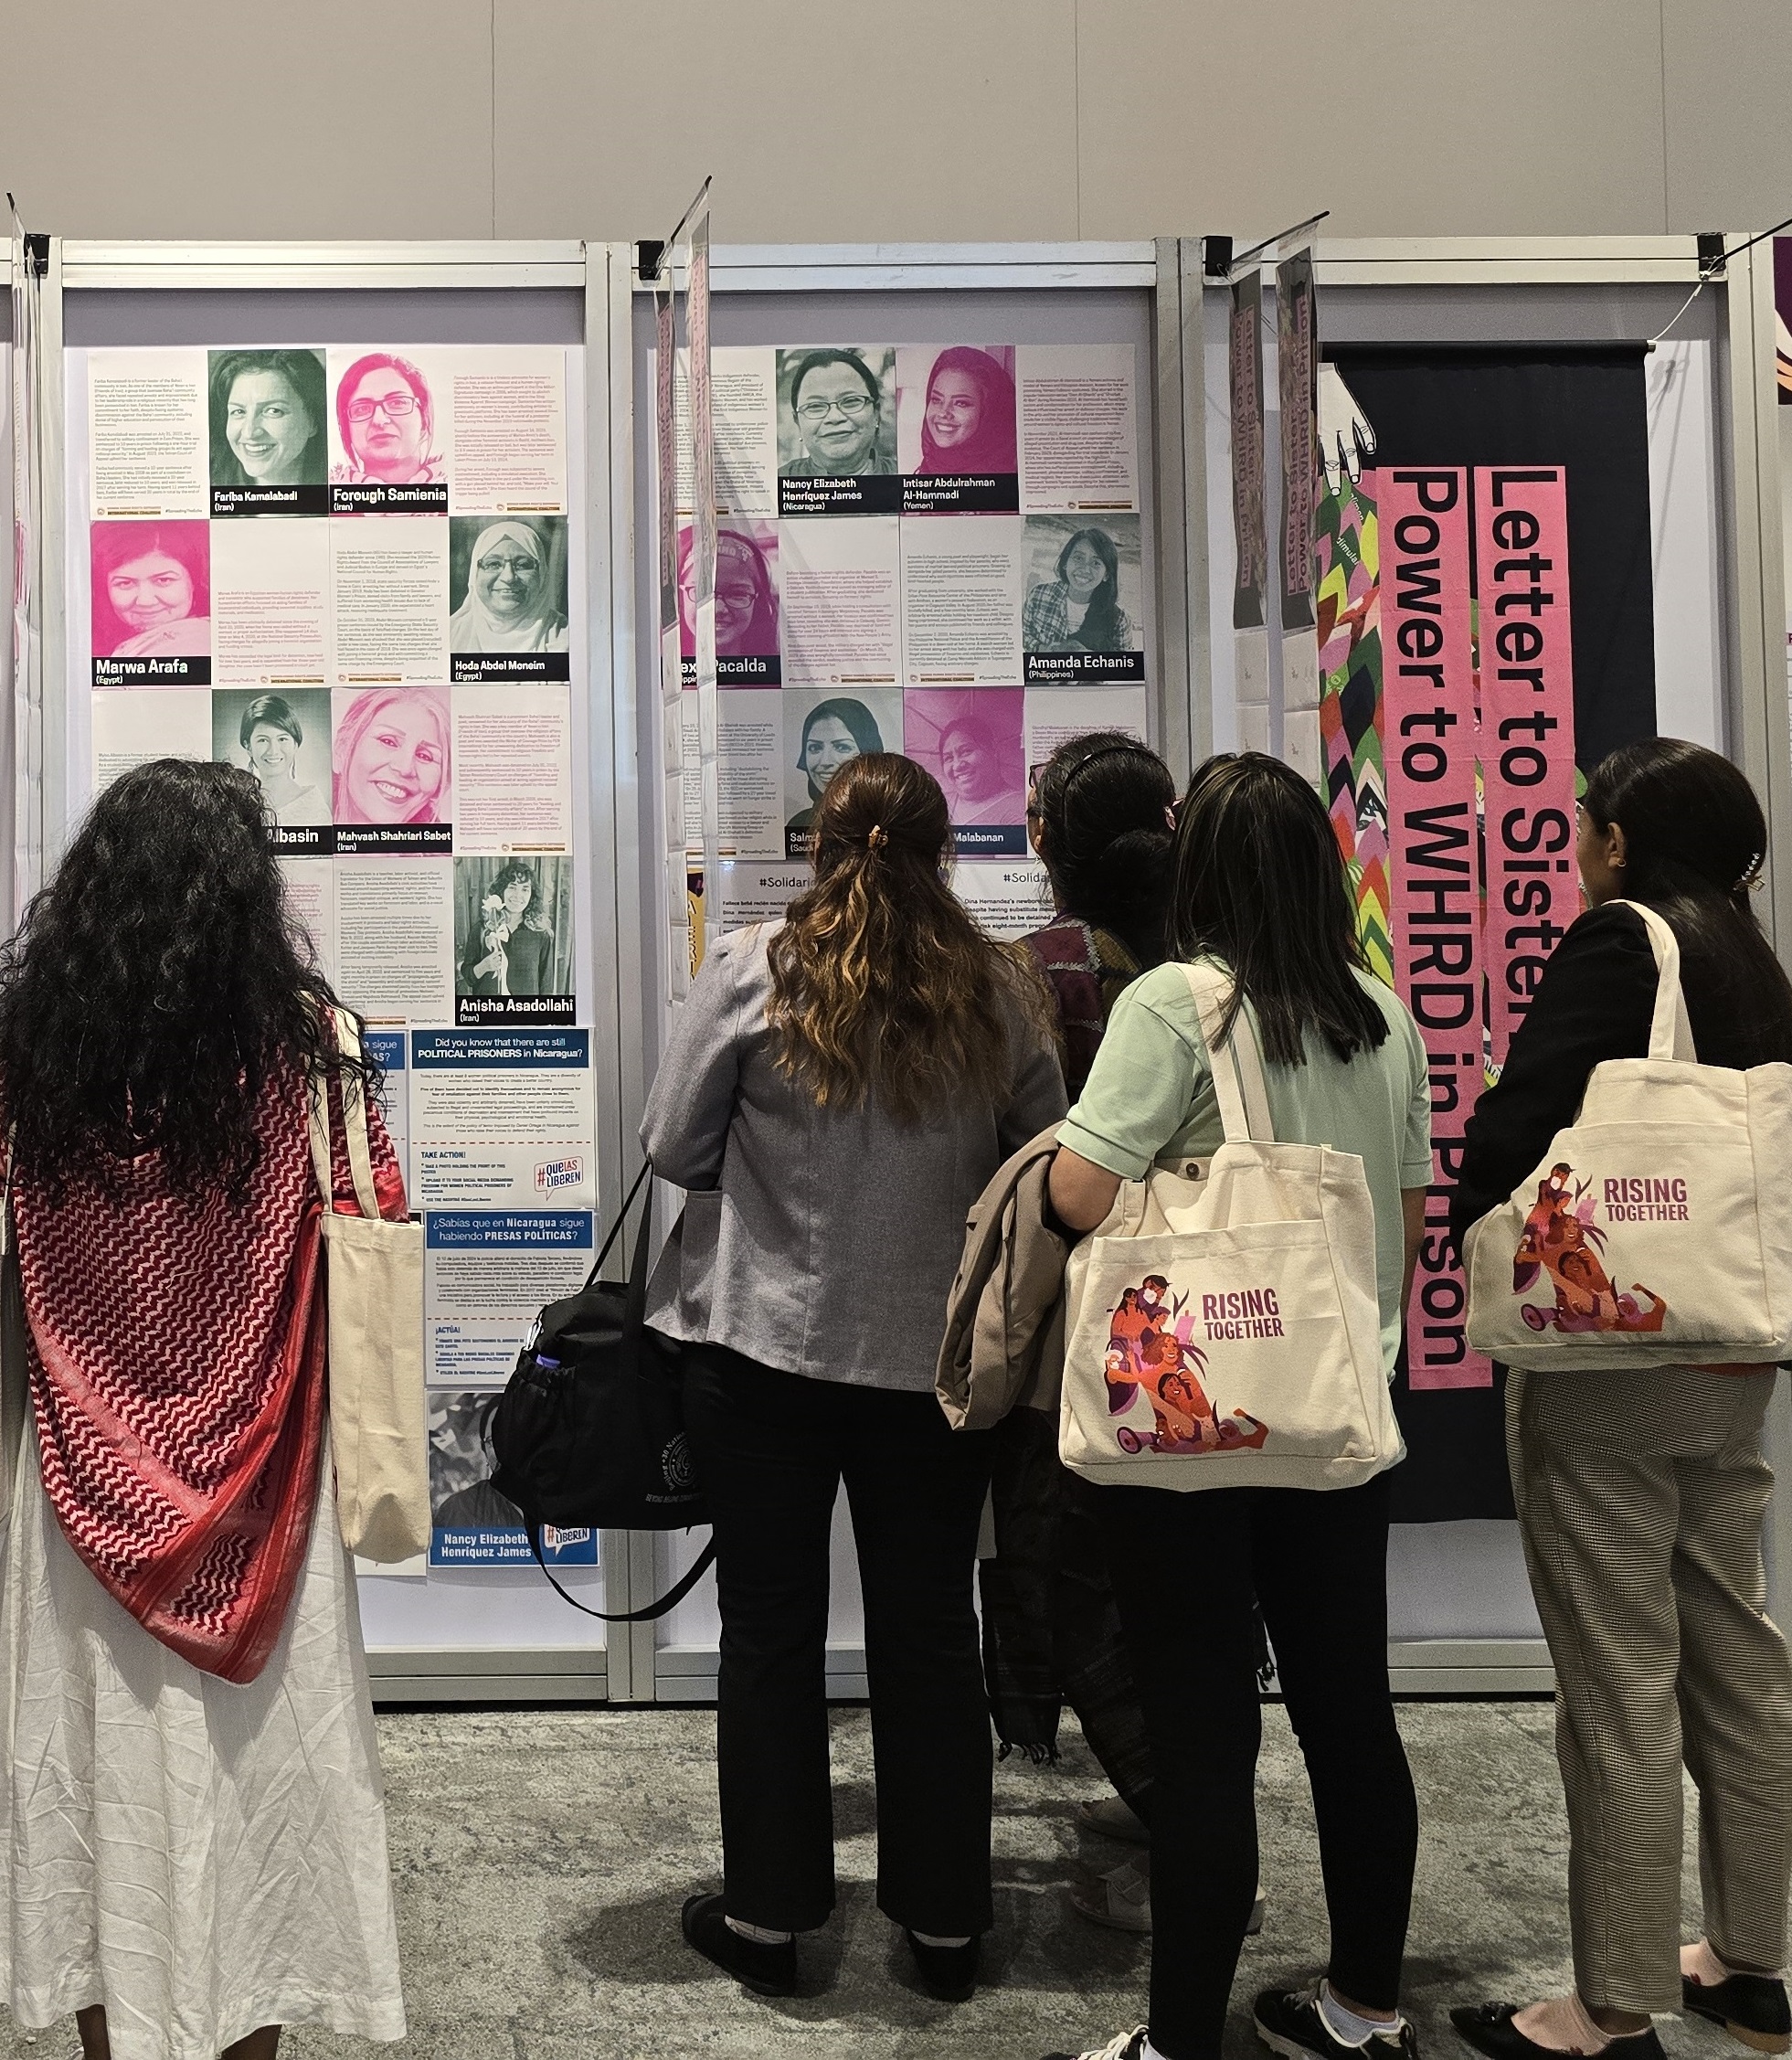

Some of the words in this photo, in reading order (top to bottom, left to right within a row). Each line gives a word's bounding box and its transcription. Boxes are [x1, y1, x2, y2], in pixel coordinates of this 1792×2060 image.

[782, 479, 811, 490] Nancy
[813, 478, 857, 488] Elizabeth
[903, 479, 933, 488] Intisar
[934, 478, 995, 487] Abdulrahman
[215, 491, 243, 502] Fariba
[245, 491, 298, 502] Kamalabadi
[334, 488, 386, 504] Forough
[388, 487, 447, 501] Samienia
[831, 491, 863, 500] James
[903, 490, 960, 500] Al-Hammadi
[215, 504, 235, 512] (Iran)
[334, 503, 354, 512] (Iran)
[782, 502, 825, 512] (Nicaragua)
[903, 502, 934, 511] (Yemen)
[1394, 471, 1458, 688] Power
[1491, 471, 1557, 692] Letter
[96, 659, 145, 674] Marwa
[148, 658, 188, 674] Arafa
[455, 661, 480, 670] Hoda
[481, 660, 507, 670] Abdel
[508, 660, 546, 670] Moneim
[1028, 655, 1081, 668] Amanda
[1084, 655, 1135, 668] Echanis
[96, 675, 123, 685] (Egypt)
[455, 672, 482, 681] (Egypt)
[1028, 670, 1075, 680] (Philippines)
[1400, 707, 1458, 782] to
[1499, 711, 1557, 786] to
[337, 831, 379, 842] Mahvash
[423, 830, 451, 841] Sabet
[790, 833, 816, 842] Salm
[337, 844, 357, 852] (Iran)
[1405, 802, 1474, 1030] WHRD
[460, 998, 504, 1013] Anisha
[506, 998, 574, 1012] Asadollahi
[460, 1014, 480, 1023] (Iran)
[372, 1039, 398, 1050] sigue
[435, 1038, 451, 1046] Did
[451, 1039, 468, 1048] you
[469, 1038, 493, 1046] know
[494, 1038, 512, 1046] that
[513, 1038, 535, 1046] there
[551, 1037, 566, 1046] still
[418, 1049, 467, 1058] POLITICAL
[468, 1049, 523, 1058] PRISONERS
[524, 1049, 531, 1057] in
[533, 1049, 583, 1059] Nicaragua?
[1427, 1053, 1475, 1112] in
[439, 1151, 466, 1159] ACTION!
[1604, 1177, 1688, 1204] RISING
[1606, 1204, 1690, 1222] TOGETHER
[433, 1218, 471, 1229] ¿Sabías
[472, 1219, 490, 1229] que
[493, 1219, 504, 1227] en
[506, 1218, 557, 1229] Nicaragua
[559, 1218, 585, 1229] sigue
[439, 1231, 482, 1240] habiendo
[484, 1231, 522, 1240] PRESAS
[524, 1229, 578, 1240] POLÍTICAS?
[1202, 1288, 1280, 1321] RISING
[1204, 1318, 1285, 1341] TOGETHER
[444, 1534, 477, 1546] Nancy
[480, 1534, 528, 1545] Elizabeth
[441, 1546, 494, 1558] Henríquez
[496, 1546, 532, 1557] James
